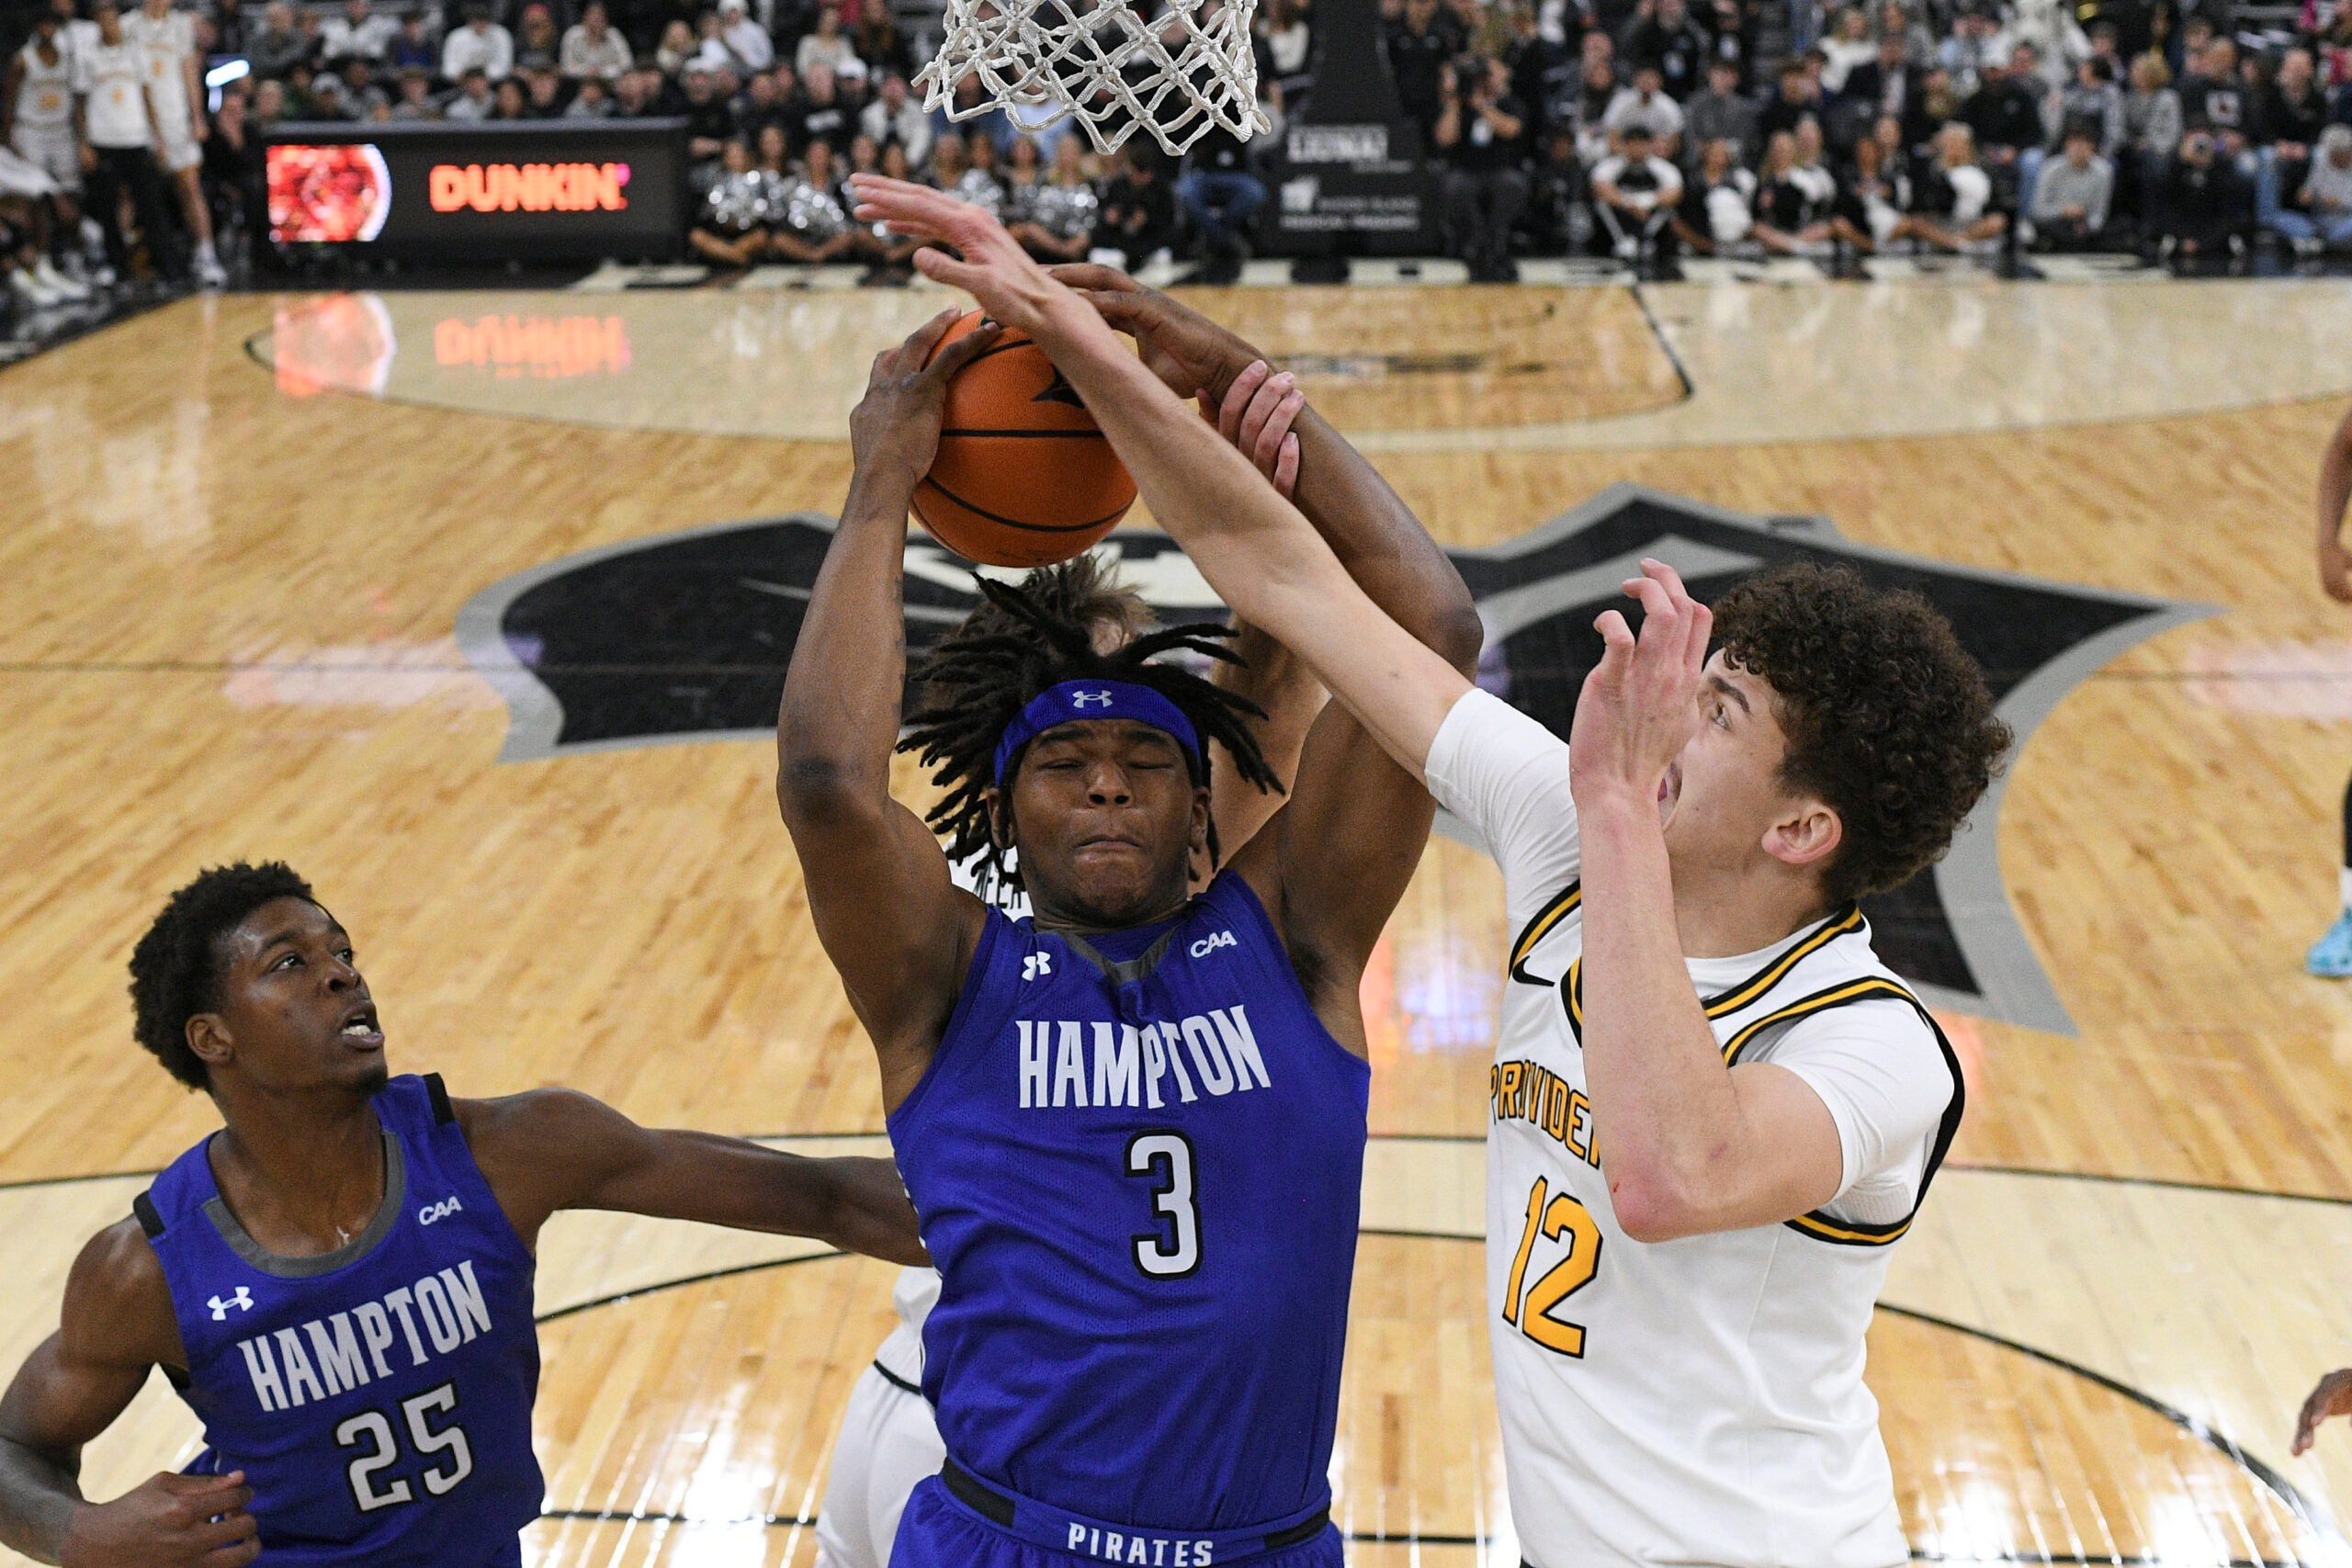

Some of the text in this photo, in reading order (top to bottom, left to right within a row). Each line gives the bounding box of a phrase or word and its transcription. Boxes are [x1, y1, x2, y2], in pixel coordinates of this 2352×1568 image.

[1190, 930, 1238, 959] CAA
[1015, 1004, 1272, 1110] HAMPTON
[419, 1196, 462, 1225] CAA
[1124, 1128, 1204, 1281] 3
[1501, 1175, 1603, 1359] 12
[237, 1259, 493, 1412] HAMPTON
[332, 1379, 474, 1514] 25
[1068, 1521, 1214, 1567] PIRATES
